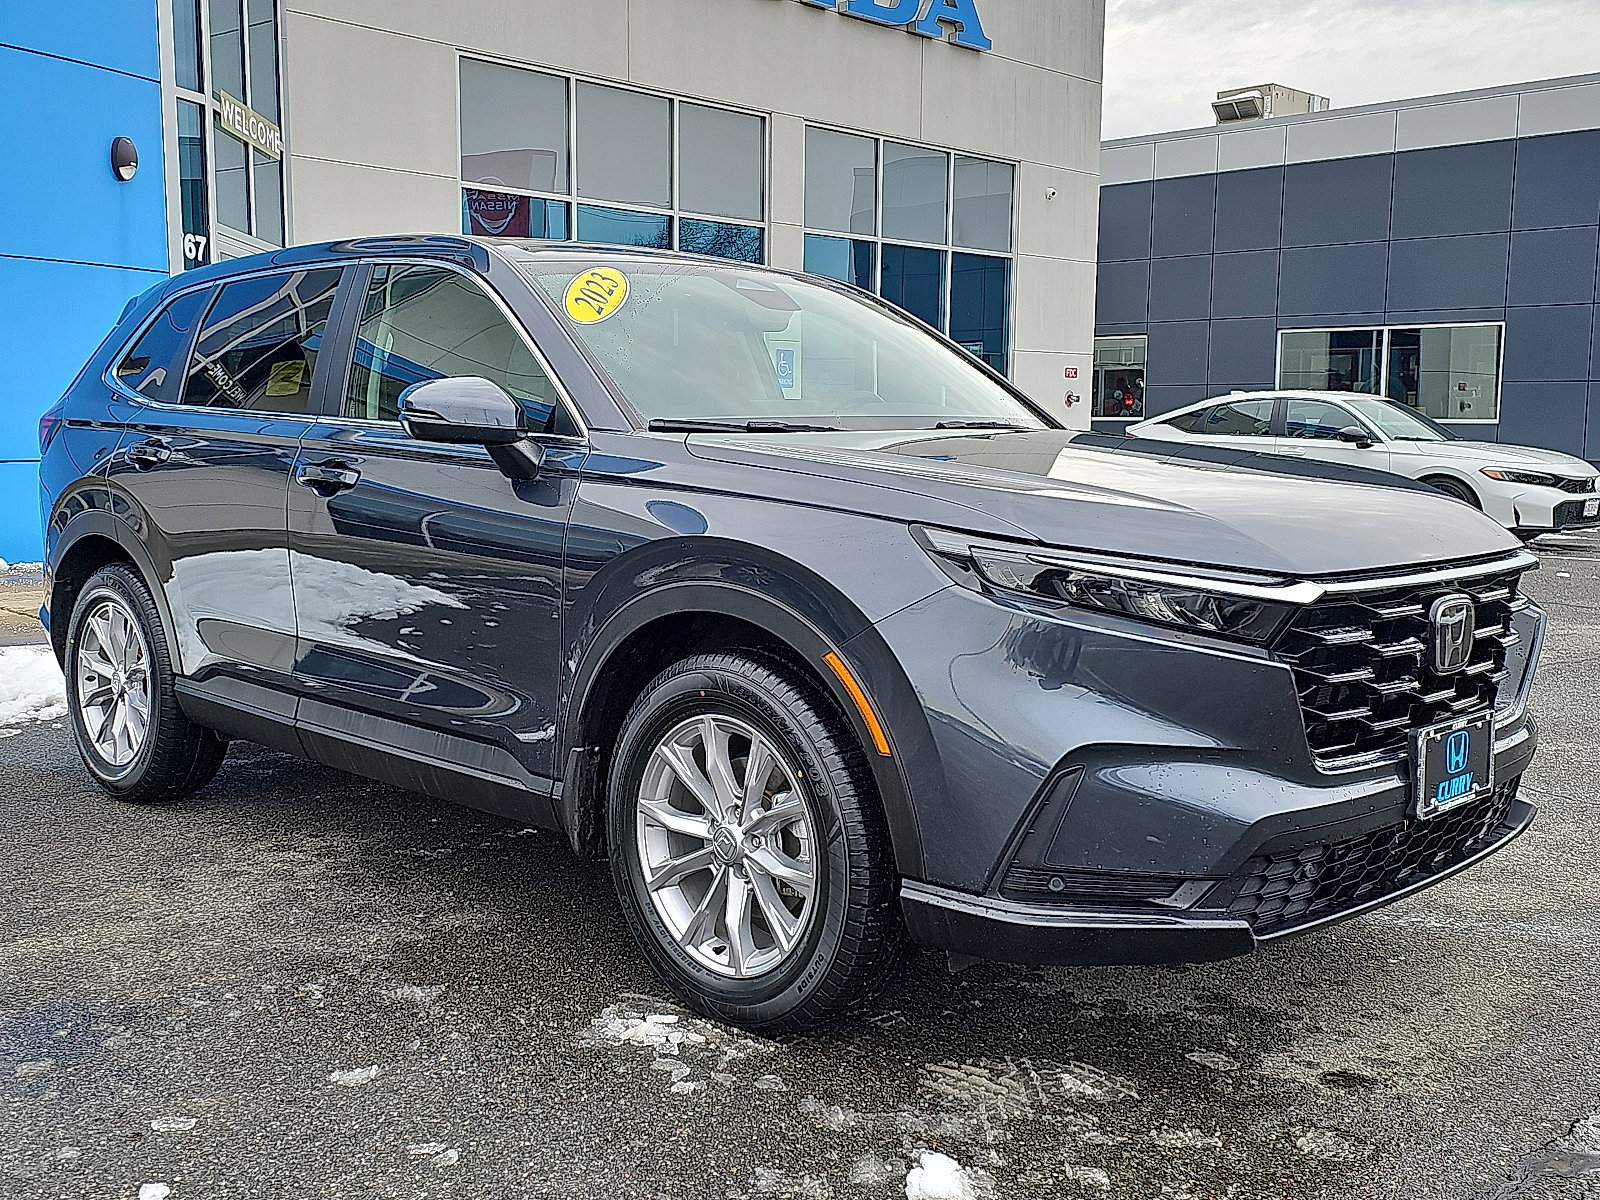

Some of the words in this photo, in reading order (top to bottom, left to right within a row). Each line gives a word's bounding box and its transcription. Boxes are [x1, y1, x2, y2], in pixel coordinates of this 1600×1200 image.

[221, 97, 281, 155] WELCOME
[183, 232, 207, 262] 67
[574, 271, 619, 316] 2023
[1065, 369, 1077, 378] FDC
[1436, 772, 1474, 802] CURRY
